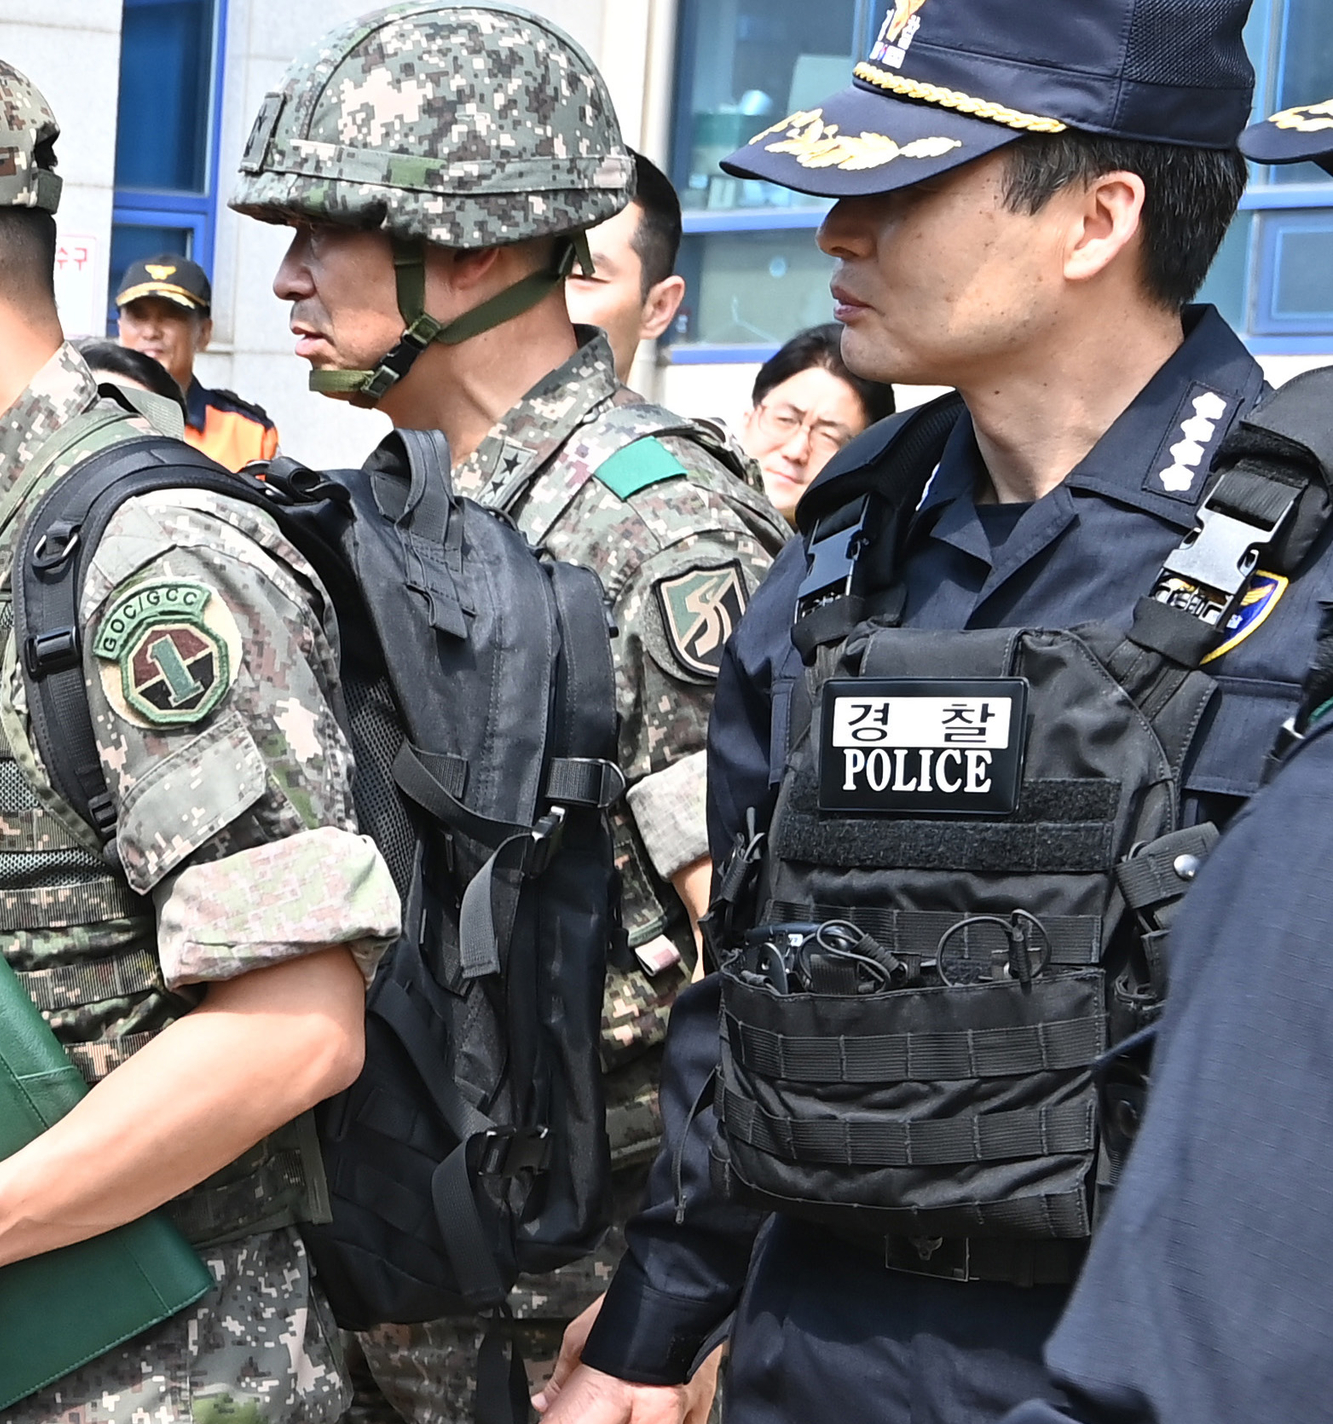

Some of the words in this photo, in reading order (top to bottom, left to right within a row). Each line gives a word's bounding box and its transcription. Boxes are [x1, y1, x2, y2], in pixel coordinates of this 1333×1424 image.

[102, 587, 198, 653] GOC/GCC
[847, 702, 996, 743] 경찰
[842, 748, 993, 793] POLICE
